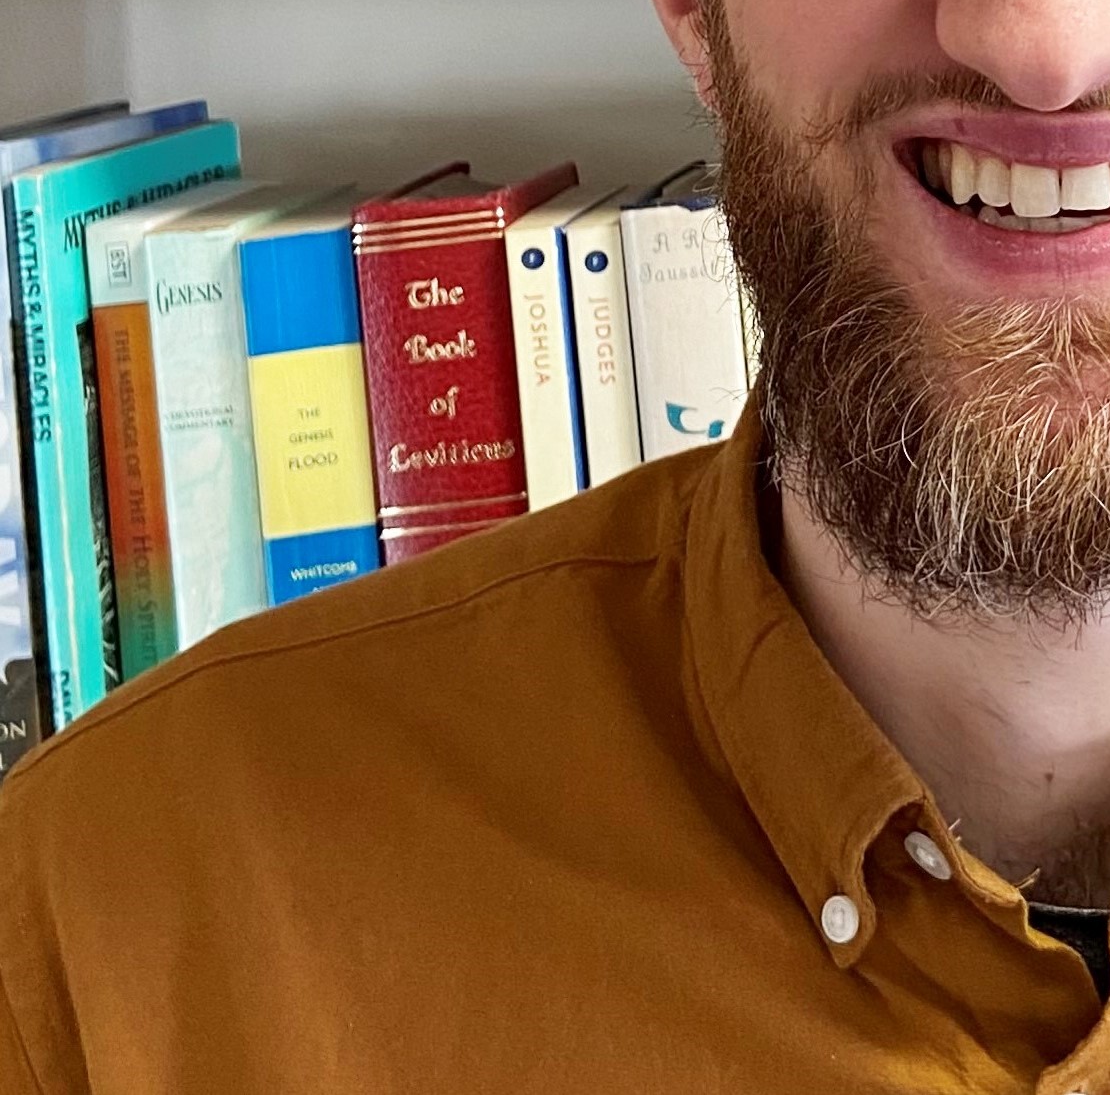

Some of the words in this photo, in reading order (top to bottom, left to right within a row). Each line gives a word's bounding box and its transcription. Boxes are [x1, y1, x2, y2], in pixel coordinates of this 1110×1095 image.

[19, 208, 42, 299] MYTHS
[156, 280, 223, 316] GENESIS
[404, 276, 466, 311] The
[403, 329, 479, 365] Book
[523, 293, 551, 386] JOSHUA
[587, 296, 617, 386] JUDGES
[29, 324, 53, 443] MIRACLES
[429, 384, 460, 421] of
[288, 451, 339, 472] FLOOD
[388, 438, 517, 474] Leviticus
